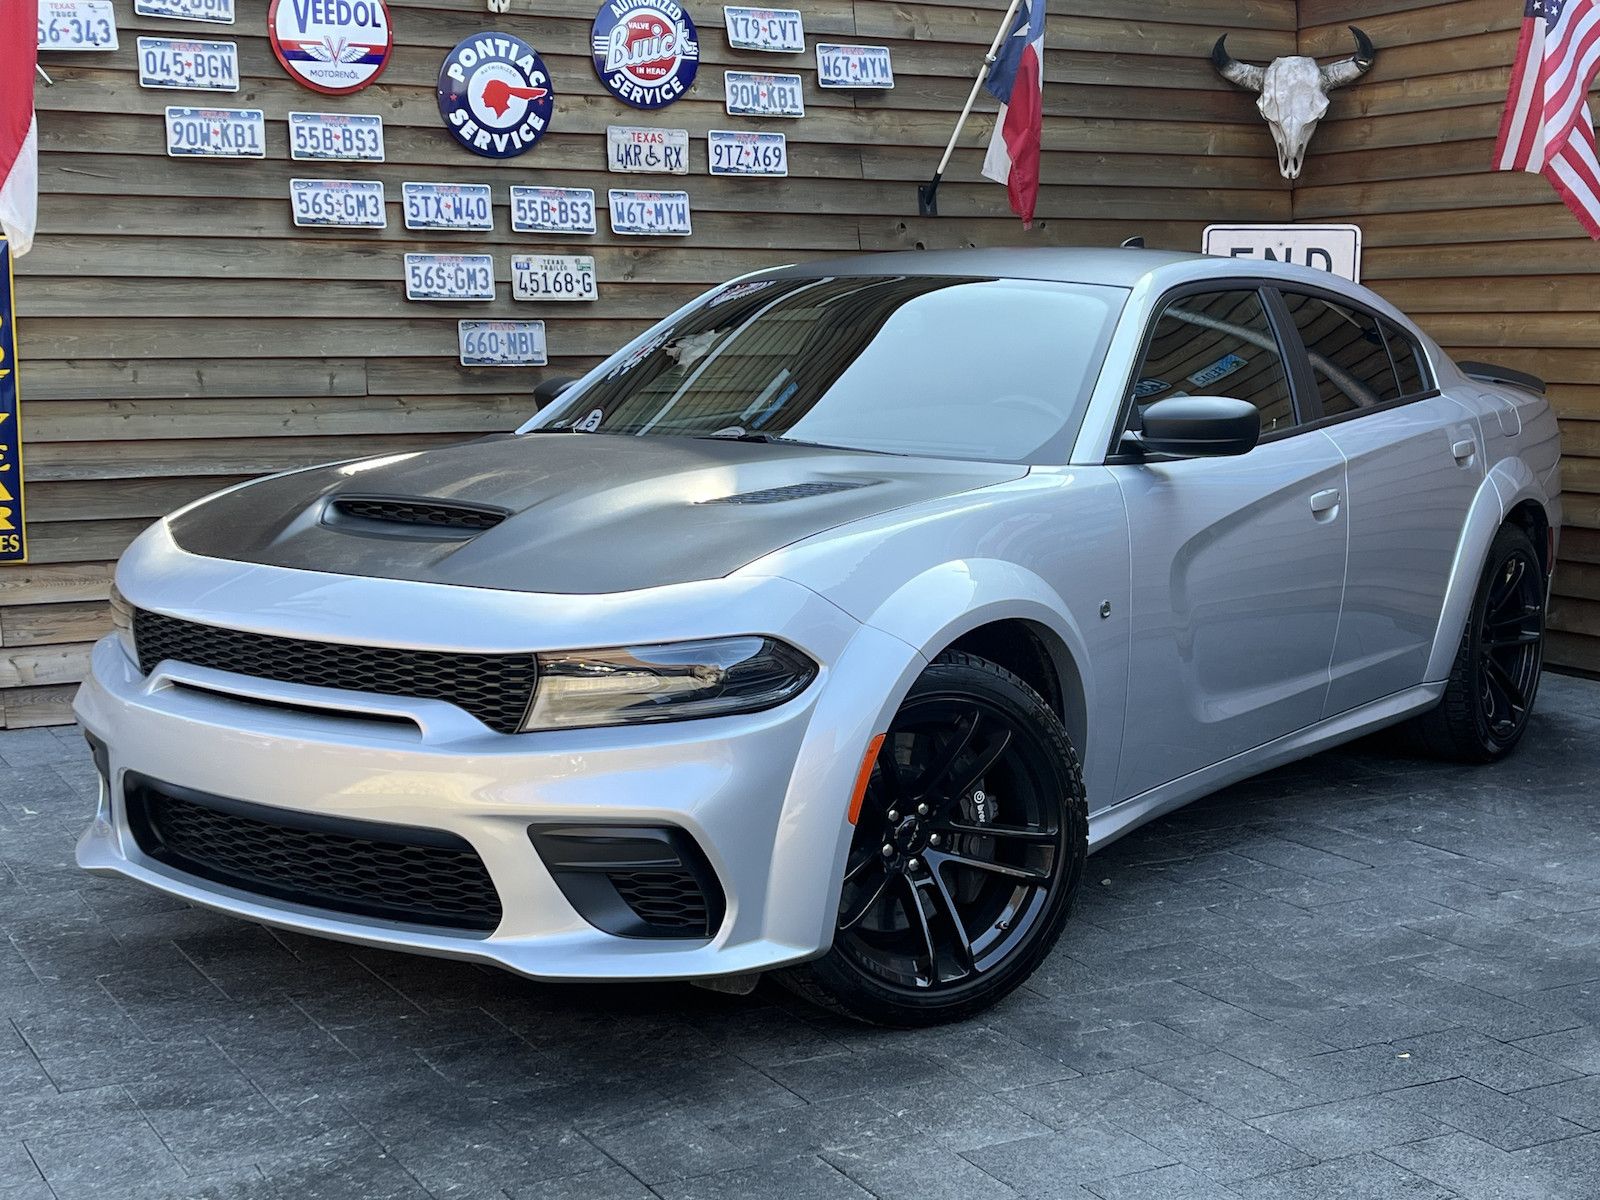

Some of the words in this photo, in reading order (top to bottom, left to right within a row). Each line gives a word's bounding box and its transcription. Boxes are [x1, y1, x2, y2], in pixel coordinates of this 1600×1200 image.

[293, 0, 381, 33] VEEDOL
[628, 22, 650, 30] VALVE
[69, 18, 111, 43] 343
[730, 17, 760, 39] Y79
[768, 19, 798, 41] CVT
[604, 19, 699, 73] Buick
[145, 51, 185, 77] 045
[194, 53, 233, 80] BGN
[447, 38, 547, 88] PONTIAC
[480, 64, 518, 78] AUTHORIZED
[646, 67, 667, 75] HEAD
[822, 56, 850, 78] W67
[609, 73, 684, 105] SERVICE
[767, 86, 799, 109] KB1
[173, 121, 211, 147] 90W
[220, 123, 259, 148] KB1
[295, 126, 333, 150] 55B
[342, 128, 379, 152] BS3
[449, 109, 545, 153] SERVICE
[631, 132, 664, 144] TEXAS
[616, 144, 642, 167] 4KR
[664, 146, 682, 168] RX
[714, 144, 744, 166] 9TZ
[752, 145, 782, 167] X69
[344, 194, 380, 218] GM3
[409, 195, 445, 220] 5TX
[516, 199, 551, 224] 55B
[558, 201, 592, 225] BS3
[615, 202, 646, 224] W67
[454, 267, 490, 291] GM3
[519, 272, 574, 293] 45168
[582, 272, 592, 293] G
[507, 333, 541, 356] NBL
